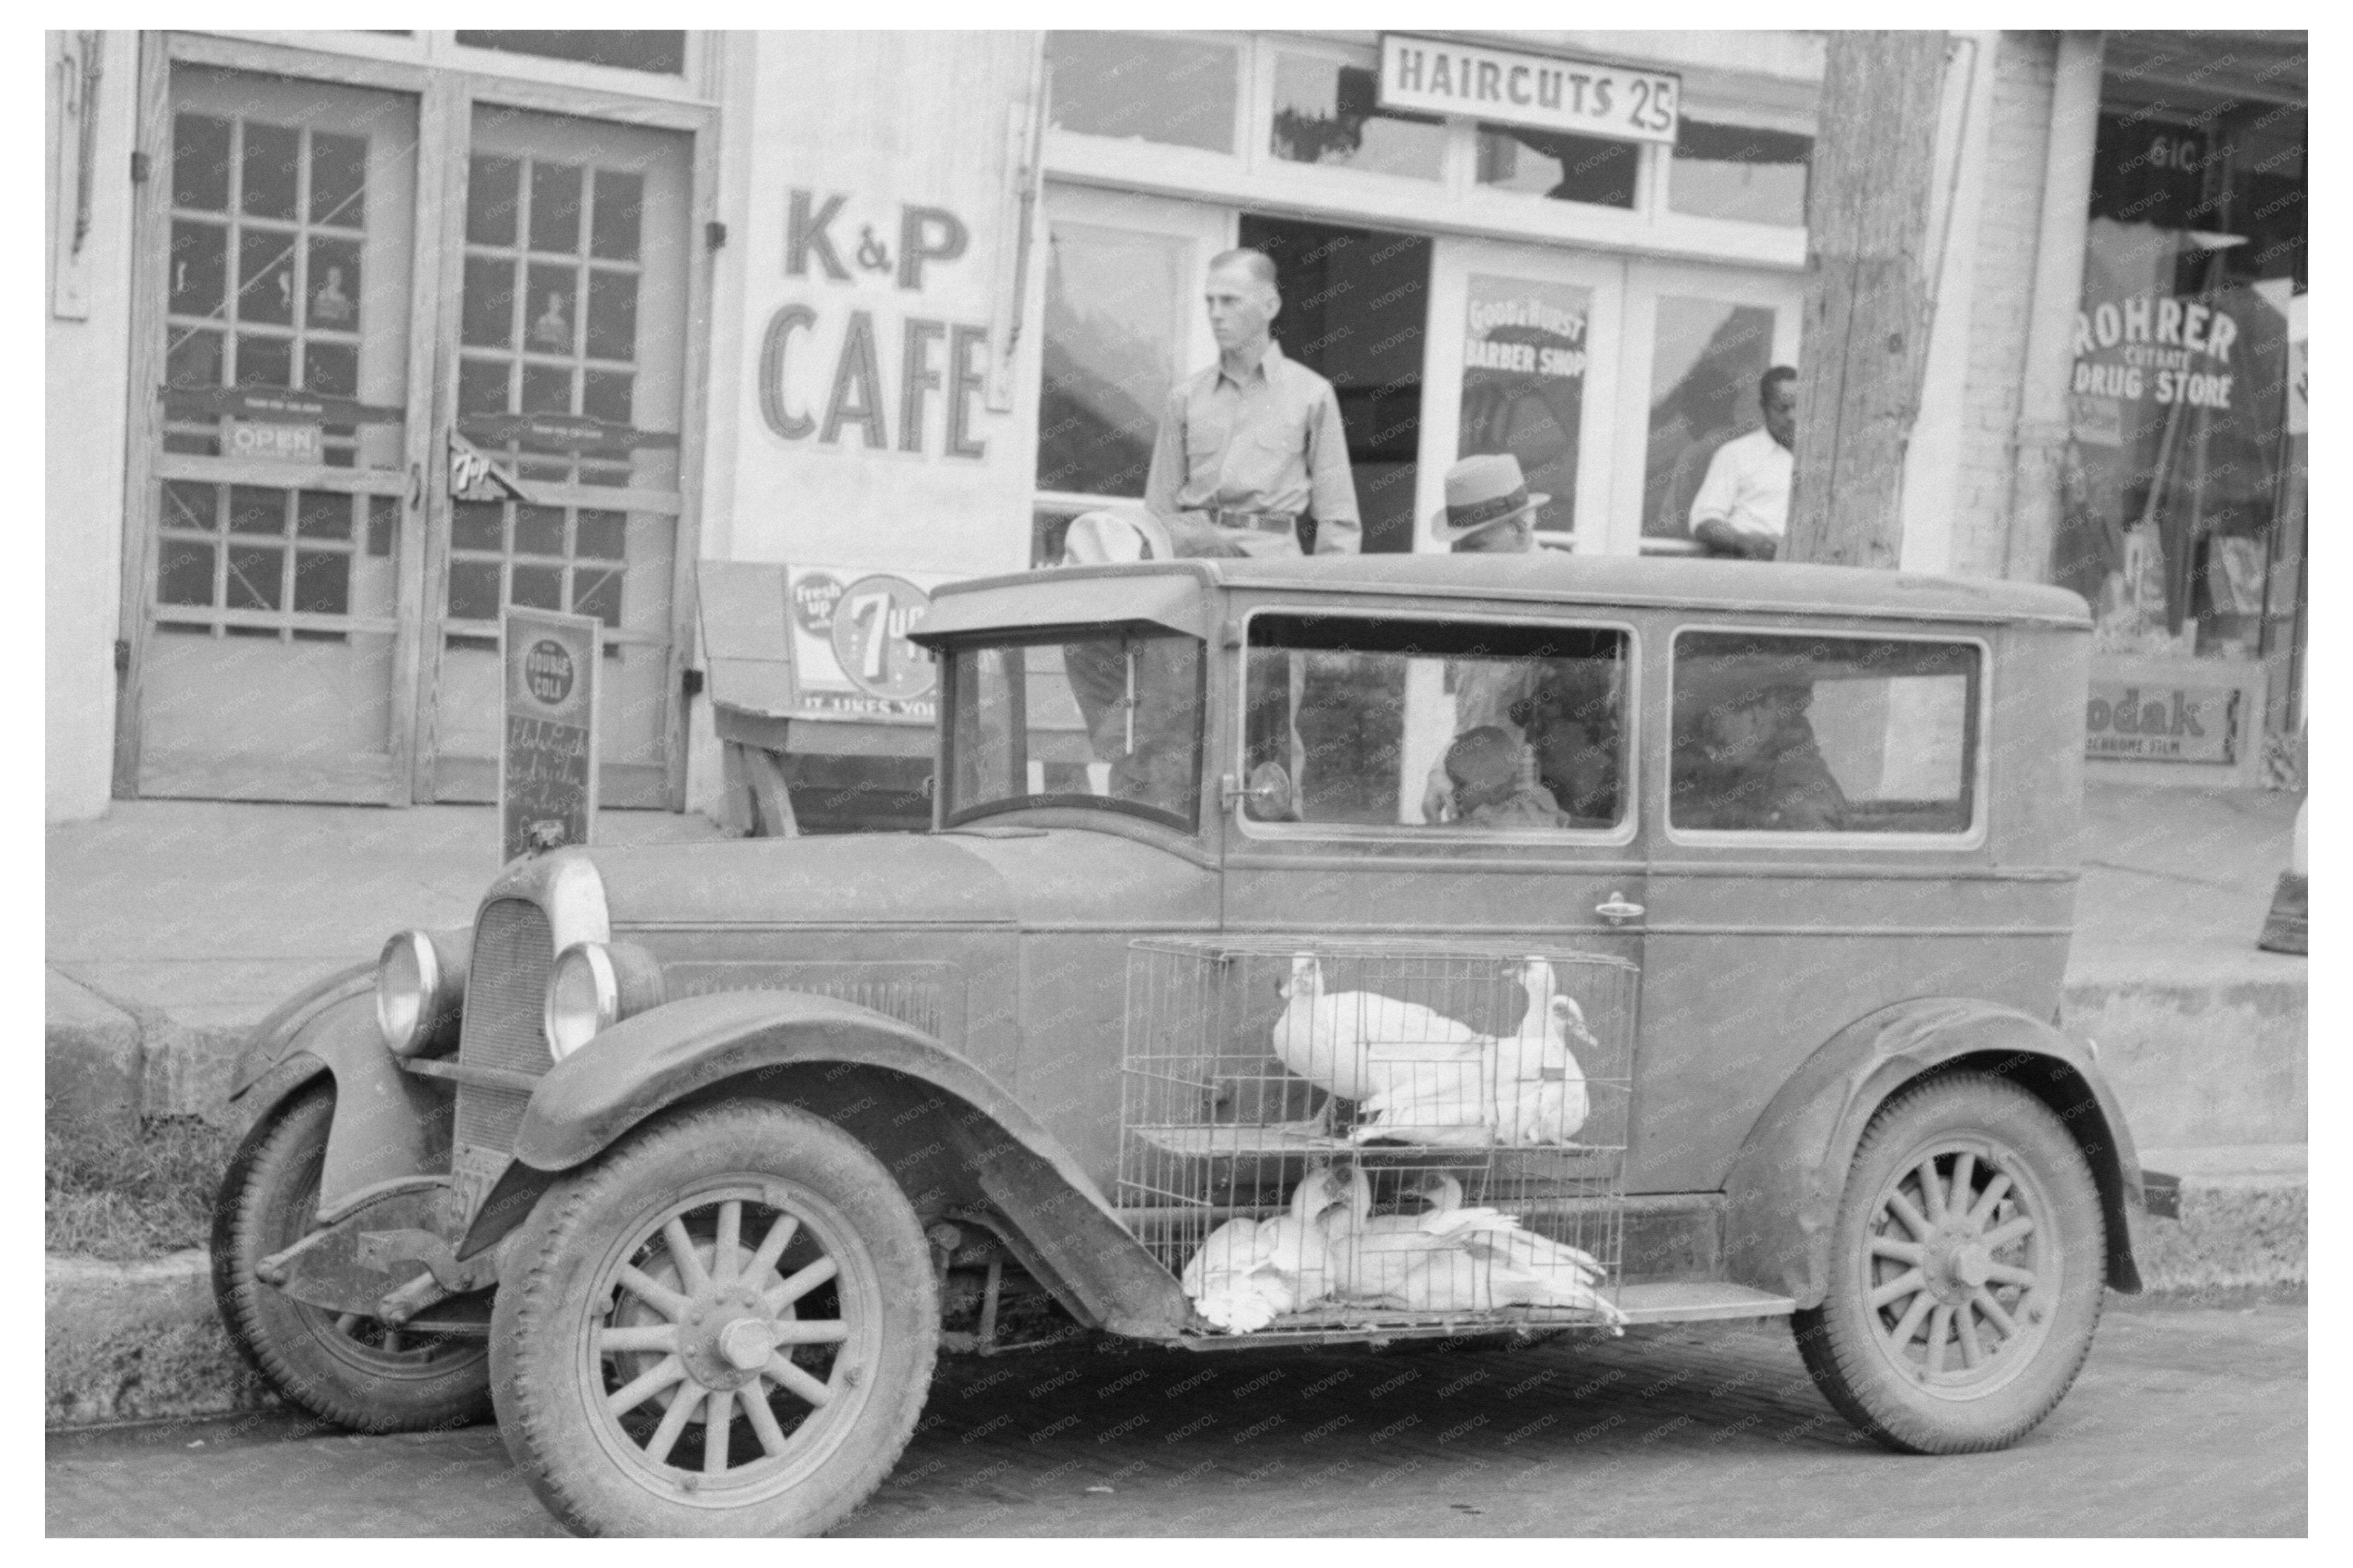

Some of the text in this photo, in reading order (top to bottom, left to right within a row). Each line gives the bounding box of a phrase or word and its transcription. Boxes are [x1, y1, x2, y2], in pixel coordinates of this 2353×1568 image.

[1398, 48, 1613, 119] HAIRCUTS
[2075, 297, 2237, 363] ROHRER
[1466, 338, 1586, 377] BARBER SHOP
[759, 303, 988, 460] CAFE
[2076, 363, 2234, 409] DRUG STORE
[235, 427, 311, 450] OPEN
[534, 677, 561, 699] COLA
[2086, 688, 2205, 737] odak
